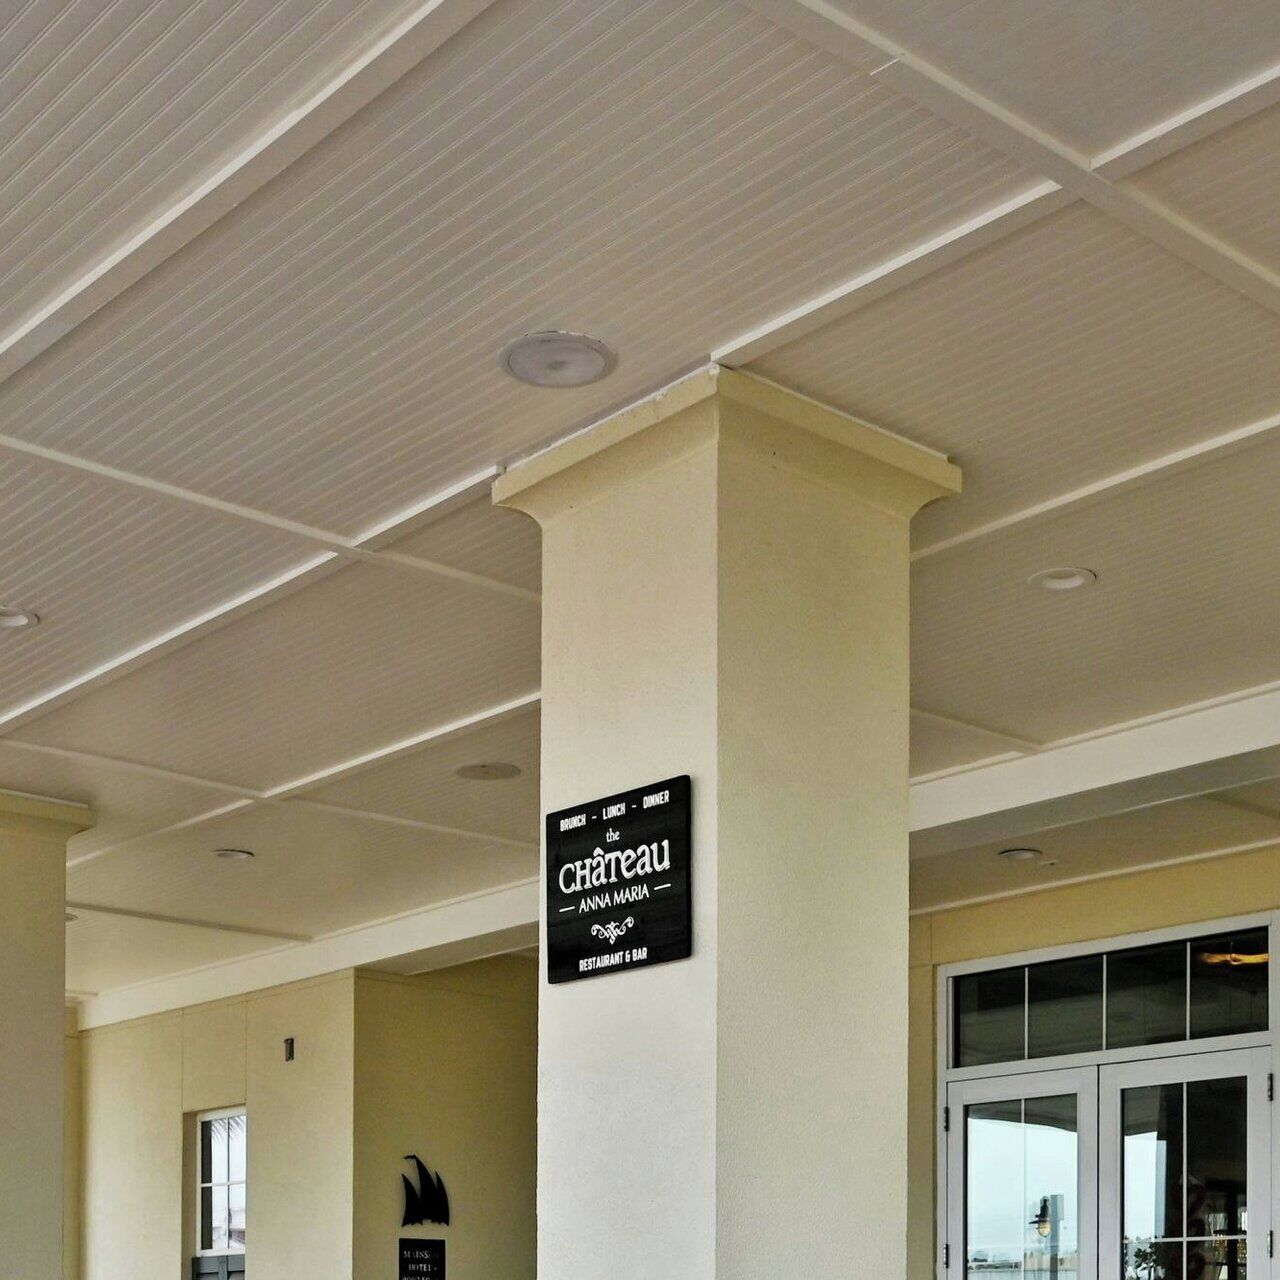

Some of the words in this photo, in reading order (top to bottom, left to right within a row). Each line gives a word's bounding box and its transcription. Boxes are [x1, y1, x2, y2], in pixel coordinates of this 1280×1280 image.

[560, 814, 586, 831] BRUNCH
[603, 803, 626, 820] LUNCH
[643, 790, 670, 809] DINNER
[606, 828, 620, 843] the
[579, 893, 612, 914] ANNA
[613, 883, 650, 906] MARIA
[579, 951, 623, 972] RESTAURANT
[632, 947, 648, 962] BAR
